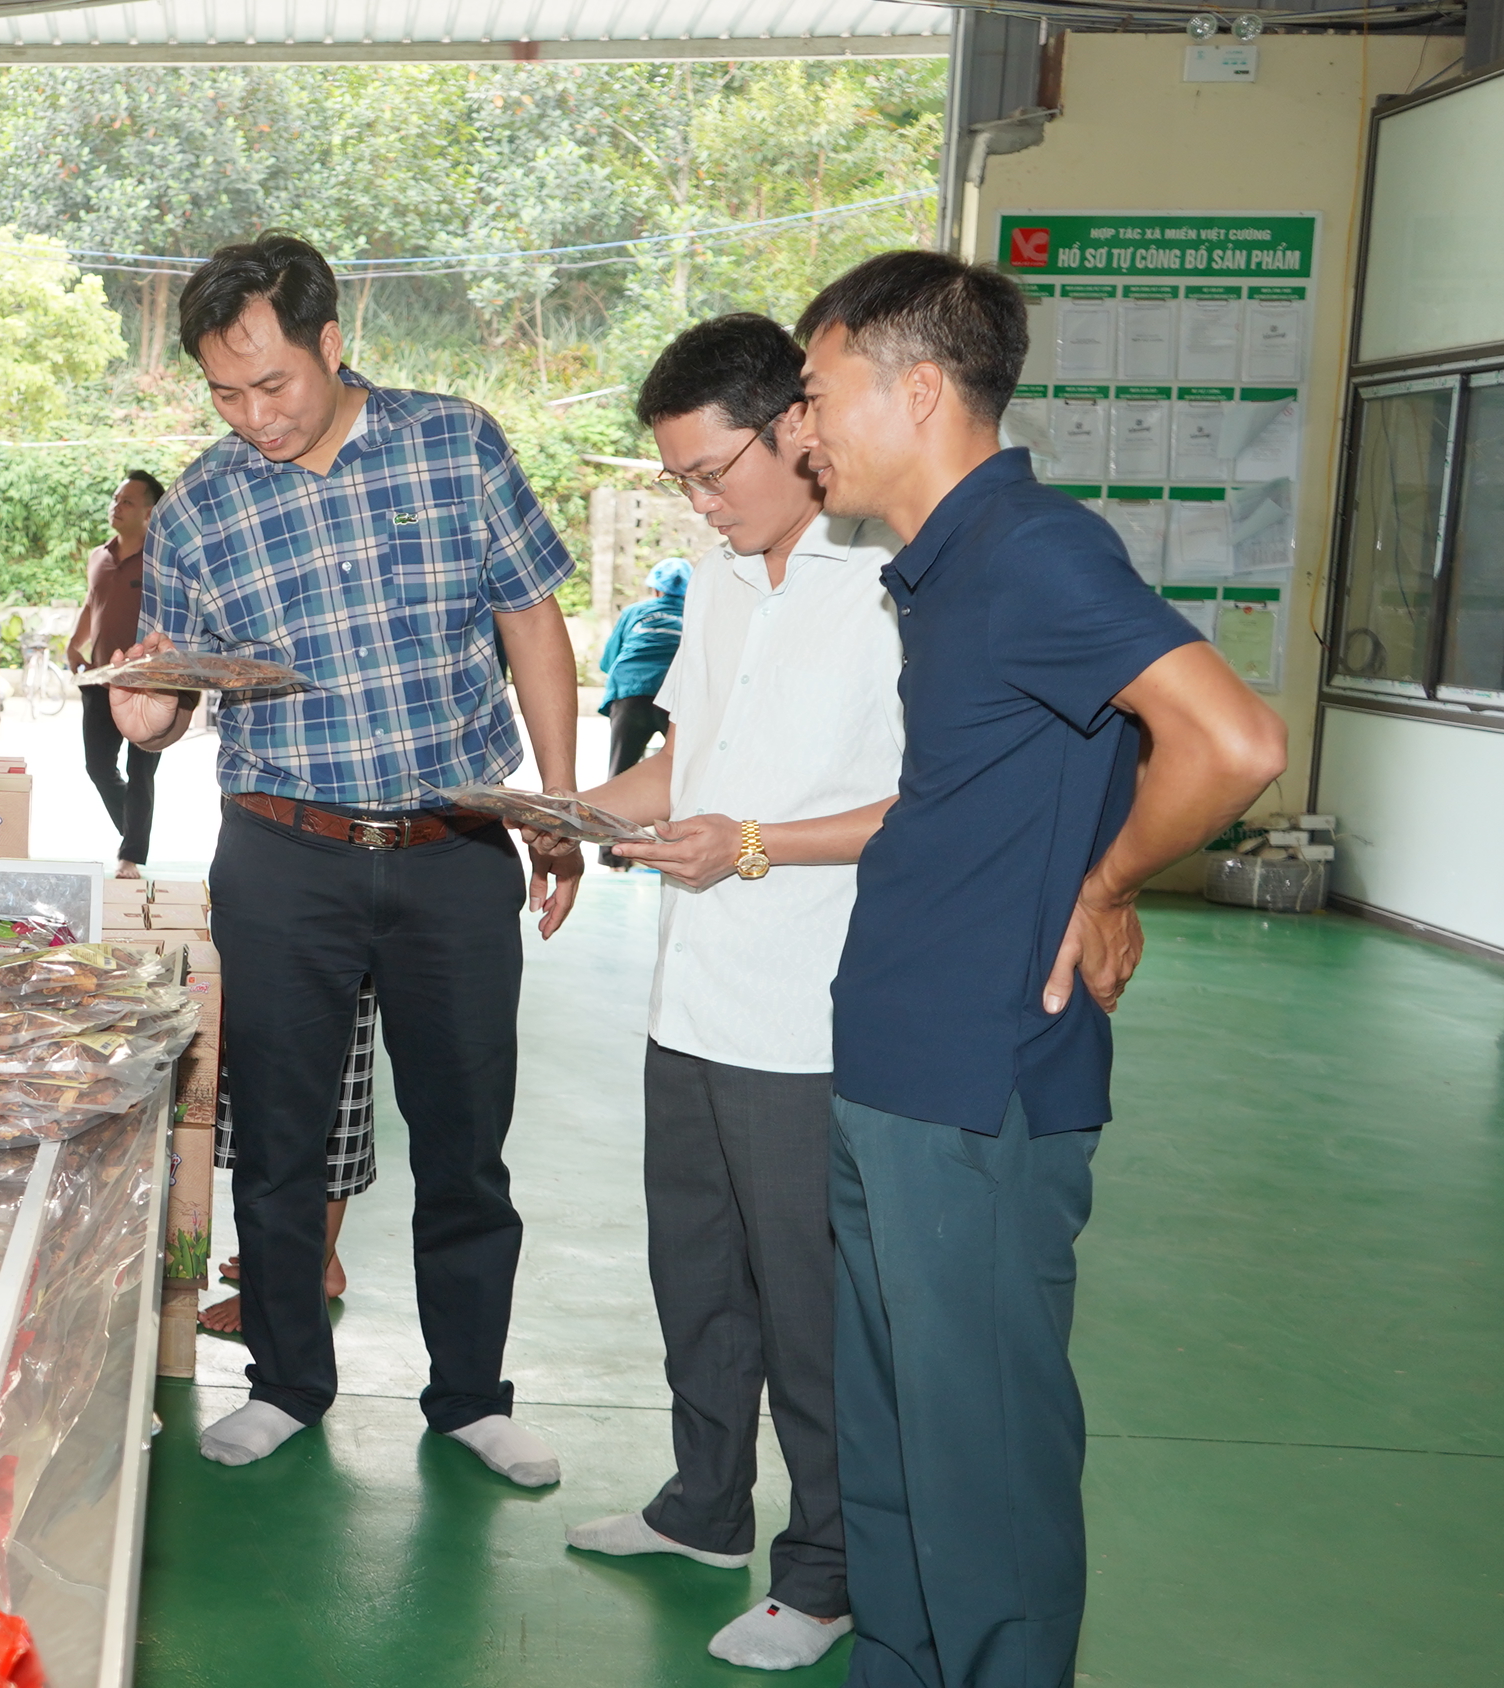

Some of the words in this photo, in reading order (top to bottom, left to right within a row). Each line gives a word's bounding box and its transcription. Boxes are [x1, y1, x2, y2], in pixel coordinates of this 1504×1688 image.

[1090, 227, 1116, 242] HỢP
[1118, 226, 1141, 240] TÁC
[1145, 226, 1162, 240] XÃ
[1164, 226, 1197, 241] MIẾN
[1200, 227, 1226, 243] VIỆT
[1228, 227, 1273, 241] CƯỜNG
[1058, 242, 1082, 268] HỒ
[1084, 247, 1109, 268] SƠ
[1112, 247, 1132, 274] TỰ
[1135, 245, 1181, 270] CÔNG
[1184, 242, 1209, 270] BỐ
[1211, 243, 1247, 271] SẢN
[1251, 241, 1301, 271] PHẨM
